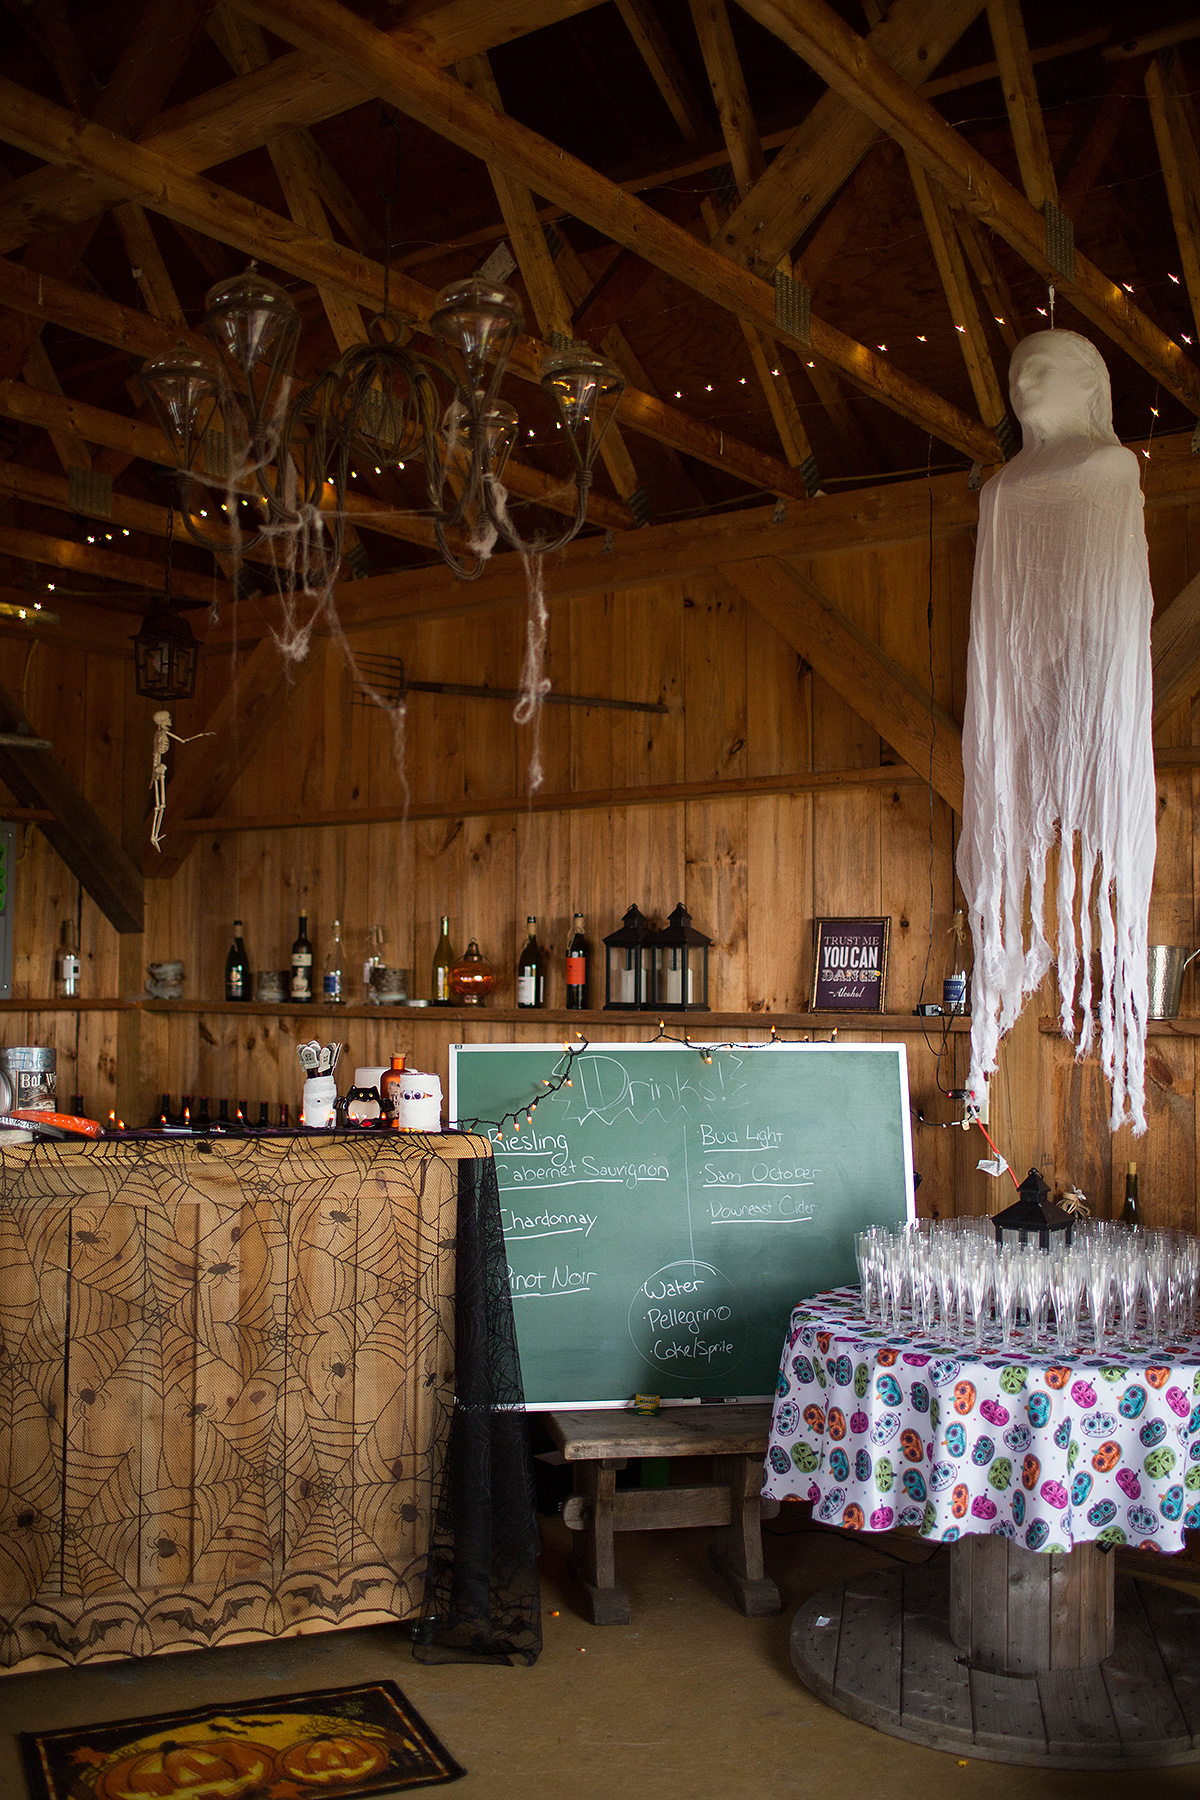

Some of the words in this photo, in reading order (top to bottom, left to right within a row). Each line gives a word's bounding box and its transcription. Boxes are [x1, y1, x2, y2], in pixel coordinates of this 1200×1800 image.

[824, 936, 860, 946] TRUST
[862, 936, 880, 946] ME
[824, 946, 849, 968] YOU
[850, 946, 879, 968] CAN
[821, 969, 878, 982] DANCE
[16, 1050, 53, 1070] TIPS
[21, 1073, 42, 1088] Bat
[577, 1055, 727, 1111] Drinks!
[487, 1128, 569, 1167] Riesling
[700, 1124, 739, 1146] Bud
[746, 1125, 784, 1148] Light
[496, 1160, 577, 1185] Cabernet
[581, 1155, 670, 1189] Sauvignon
[704, 1163, 741, 1184] Sam
[751, 1160, 822, 1182] October
[709, 1200, 773, 1219] Downeast
[778, 1194, 818, 1216] Cider
[496, 1209, 598, 1237] Chardonnay
[551, 1265, 597, 1289] Noir
[643, 1279, 705, 1300] Water
[647, 1305, 732, 1335] Pellegrino
[653, 1337, 734, 1363] Coke/Sprite
